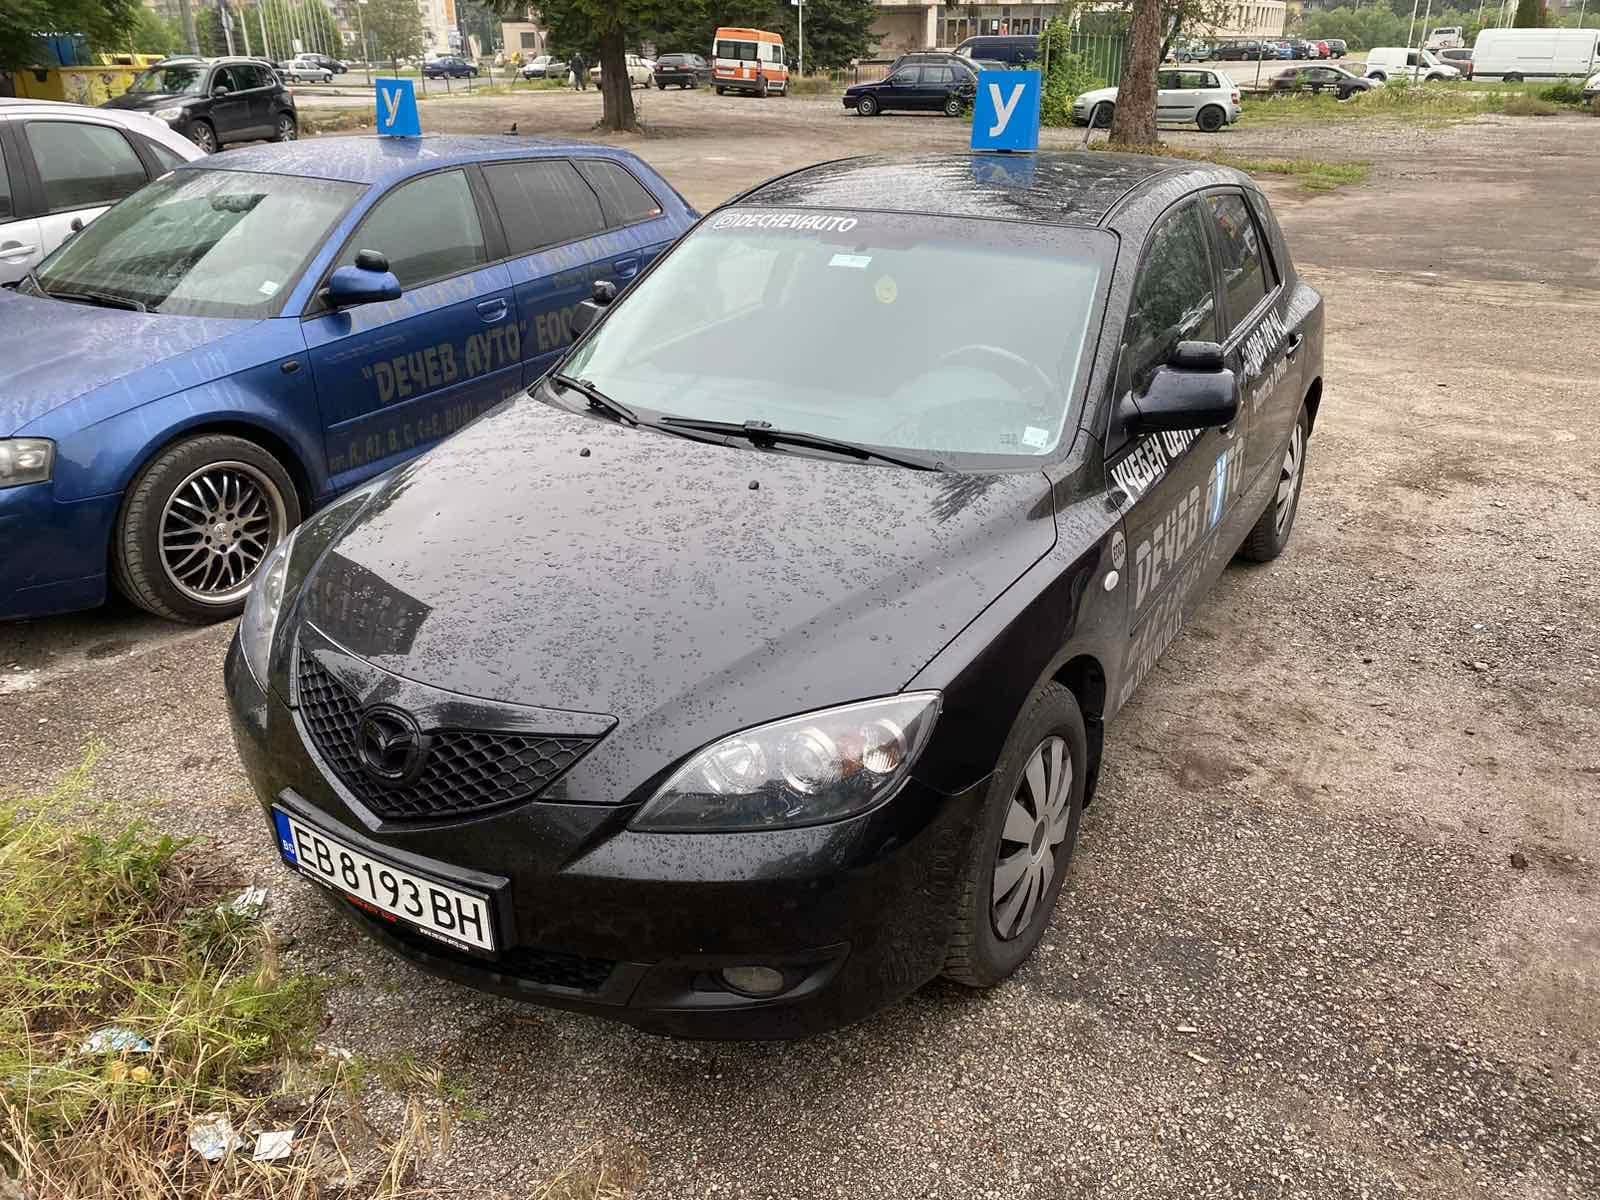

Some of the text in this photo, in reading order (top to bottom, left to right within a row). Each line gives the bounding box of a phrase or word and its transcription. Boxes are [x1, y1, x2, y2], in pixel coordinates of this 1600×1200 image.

[713, 213, 858, 233] @DECHEVAUTO
[535, 308, 575, 352] ЕОО
[1110, 433, 1168, 505] УЧЕБЕН
